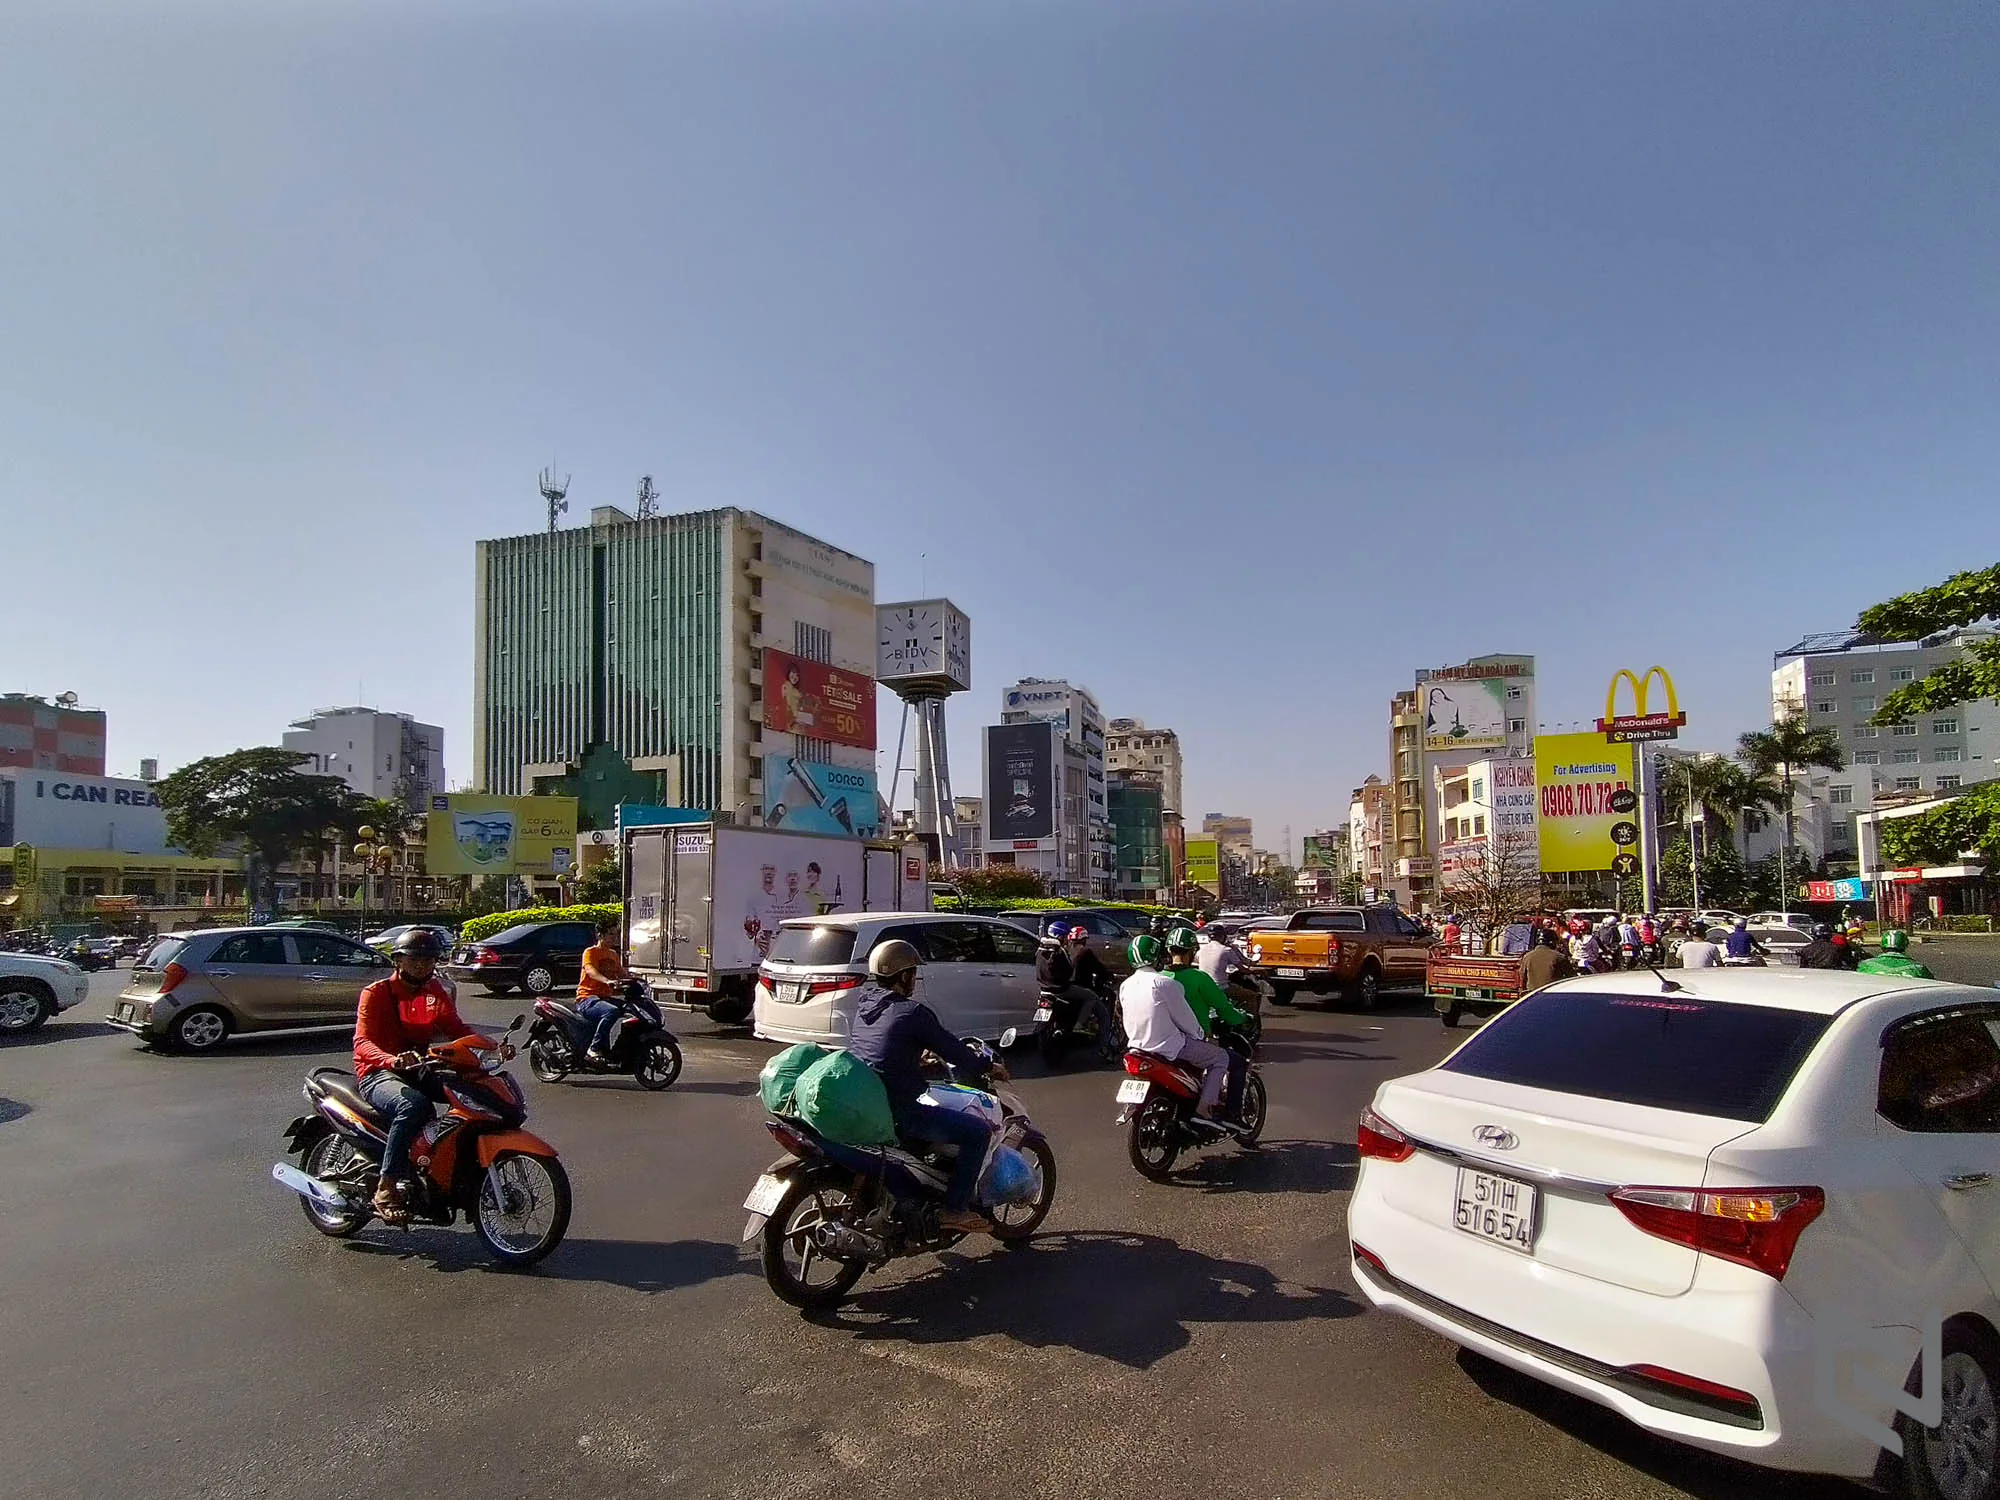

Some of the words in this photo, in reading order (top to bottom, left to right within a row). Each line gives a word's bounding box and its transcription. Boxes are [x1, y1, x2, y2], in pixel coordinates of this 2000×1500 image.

[894, 646, 928, 660] BIDV
[1022, 691, 1063, 702] VNPT
[1614, 717, 1670, 728] McDonald's
[1627, 731, 1650, 739] Drive
[1553, 765, 1567, 775] For
[1569, 763, 1616, 775] Advertising
[828, 772, 865, 787] DORCO
[36, 781, 44, 798] I
[52, 782, 107, 803] CAN
[540, 825, 551, 837] 6
[1475, 1174, 1517, 1211] 51H
[1457, 1198, 1529, 1247] 516.54
